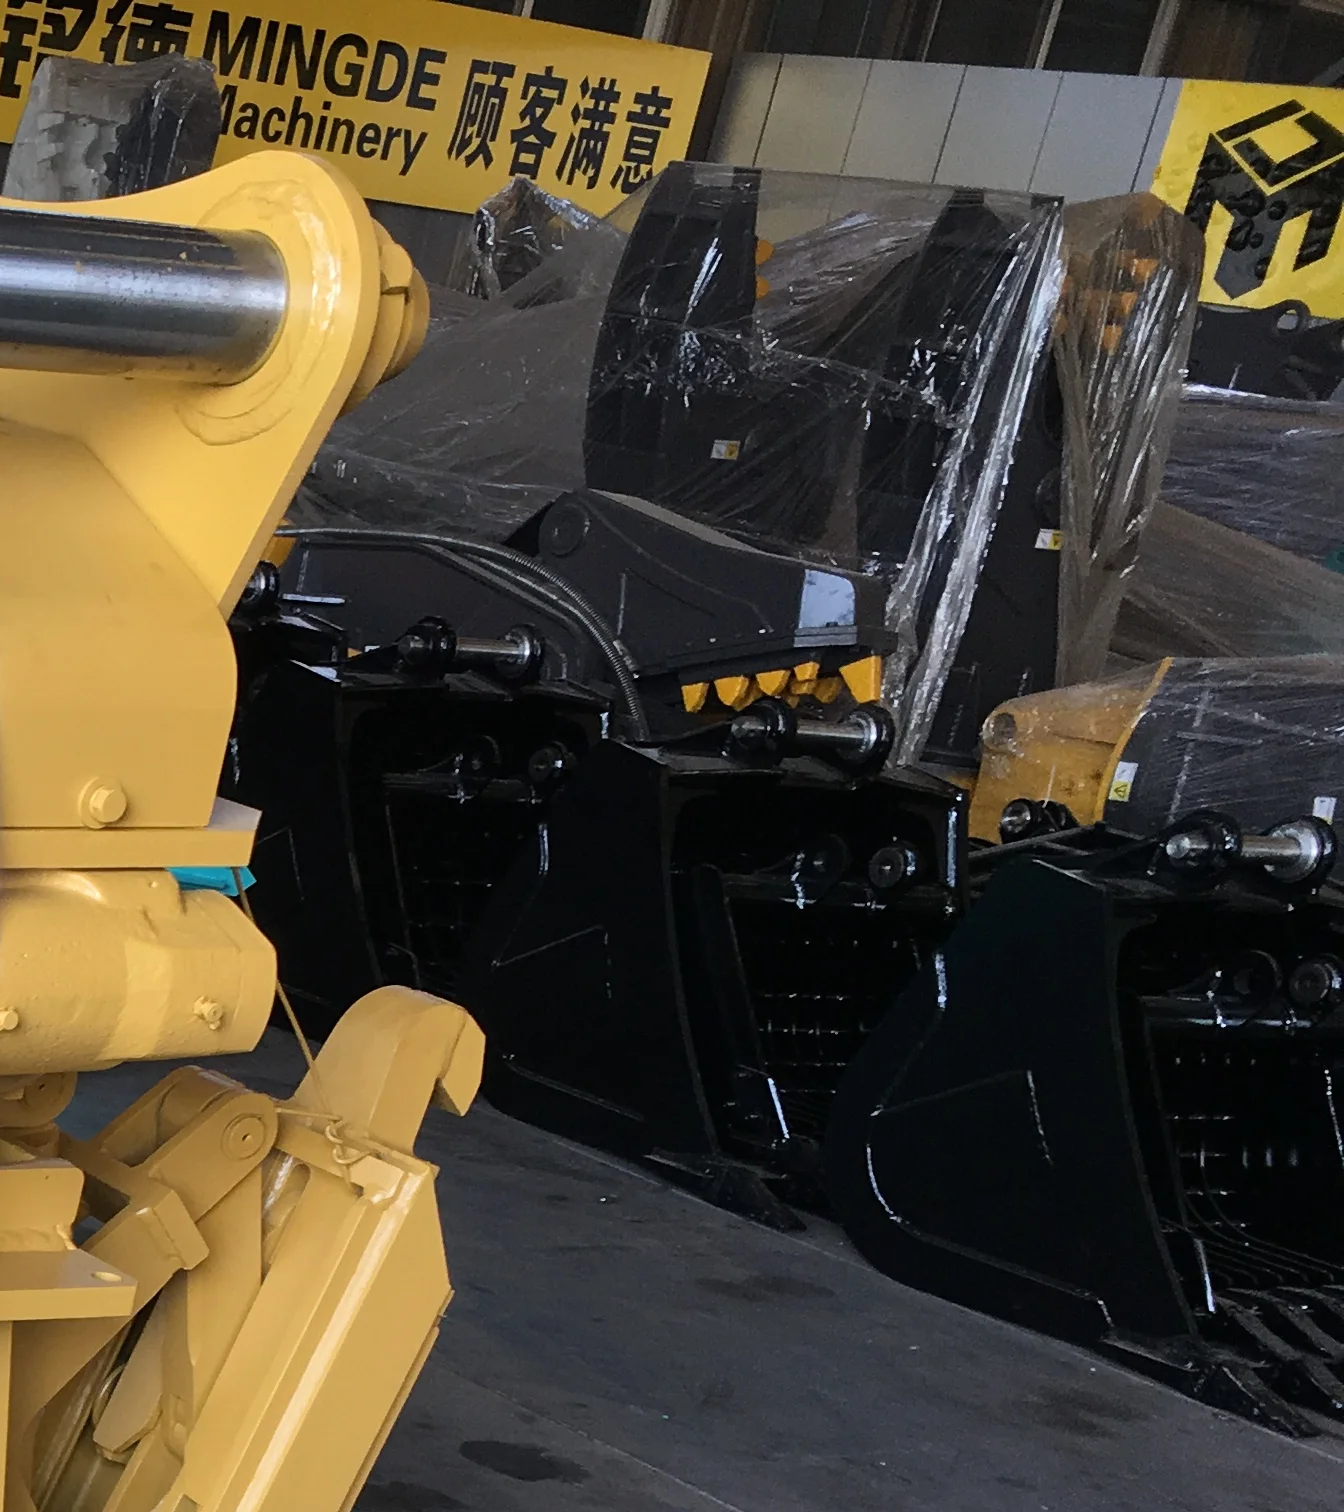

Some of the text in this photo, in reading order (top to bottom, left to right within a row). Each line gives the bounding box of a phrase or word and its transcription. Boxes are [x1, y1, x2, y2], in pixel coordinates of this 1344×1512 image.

[203, 10, 447, 110] MINGDE
[447, 59, 673, 194] 顾客满意
